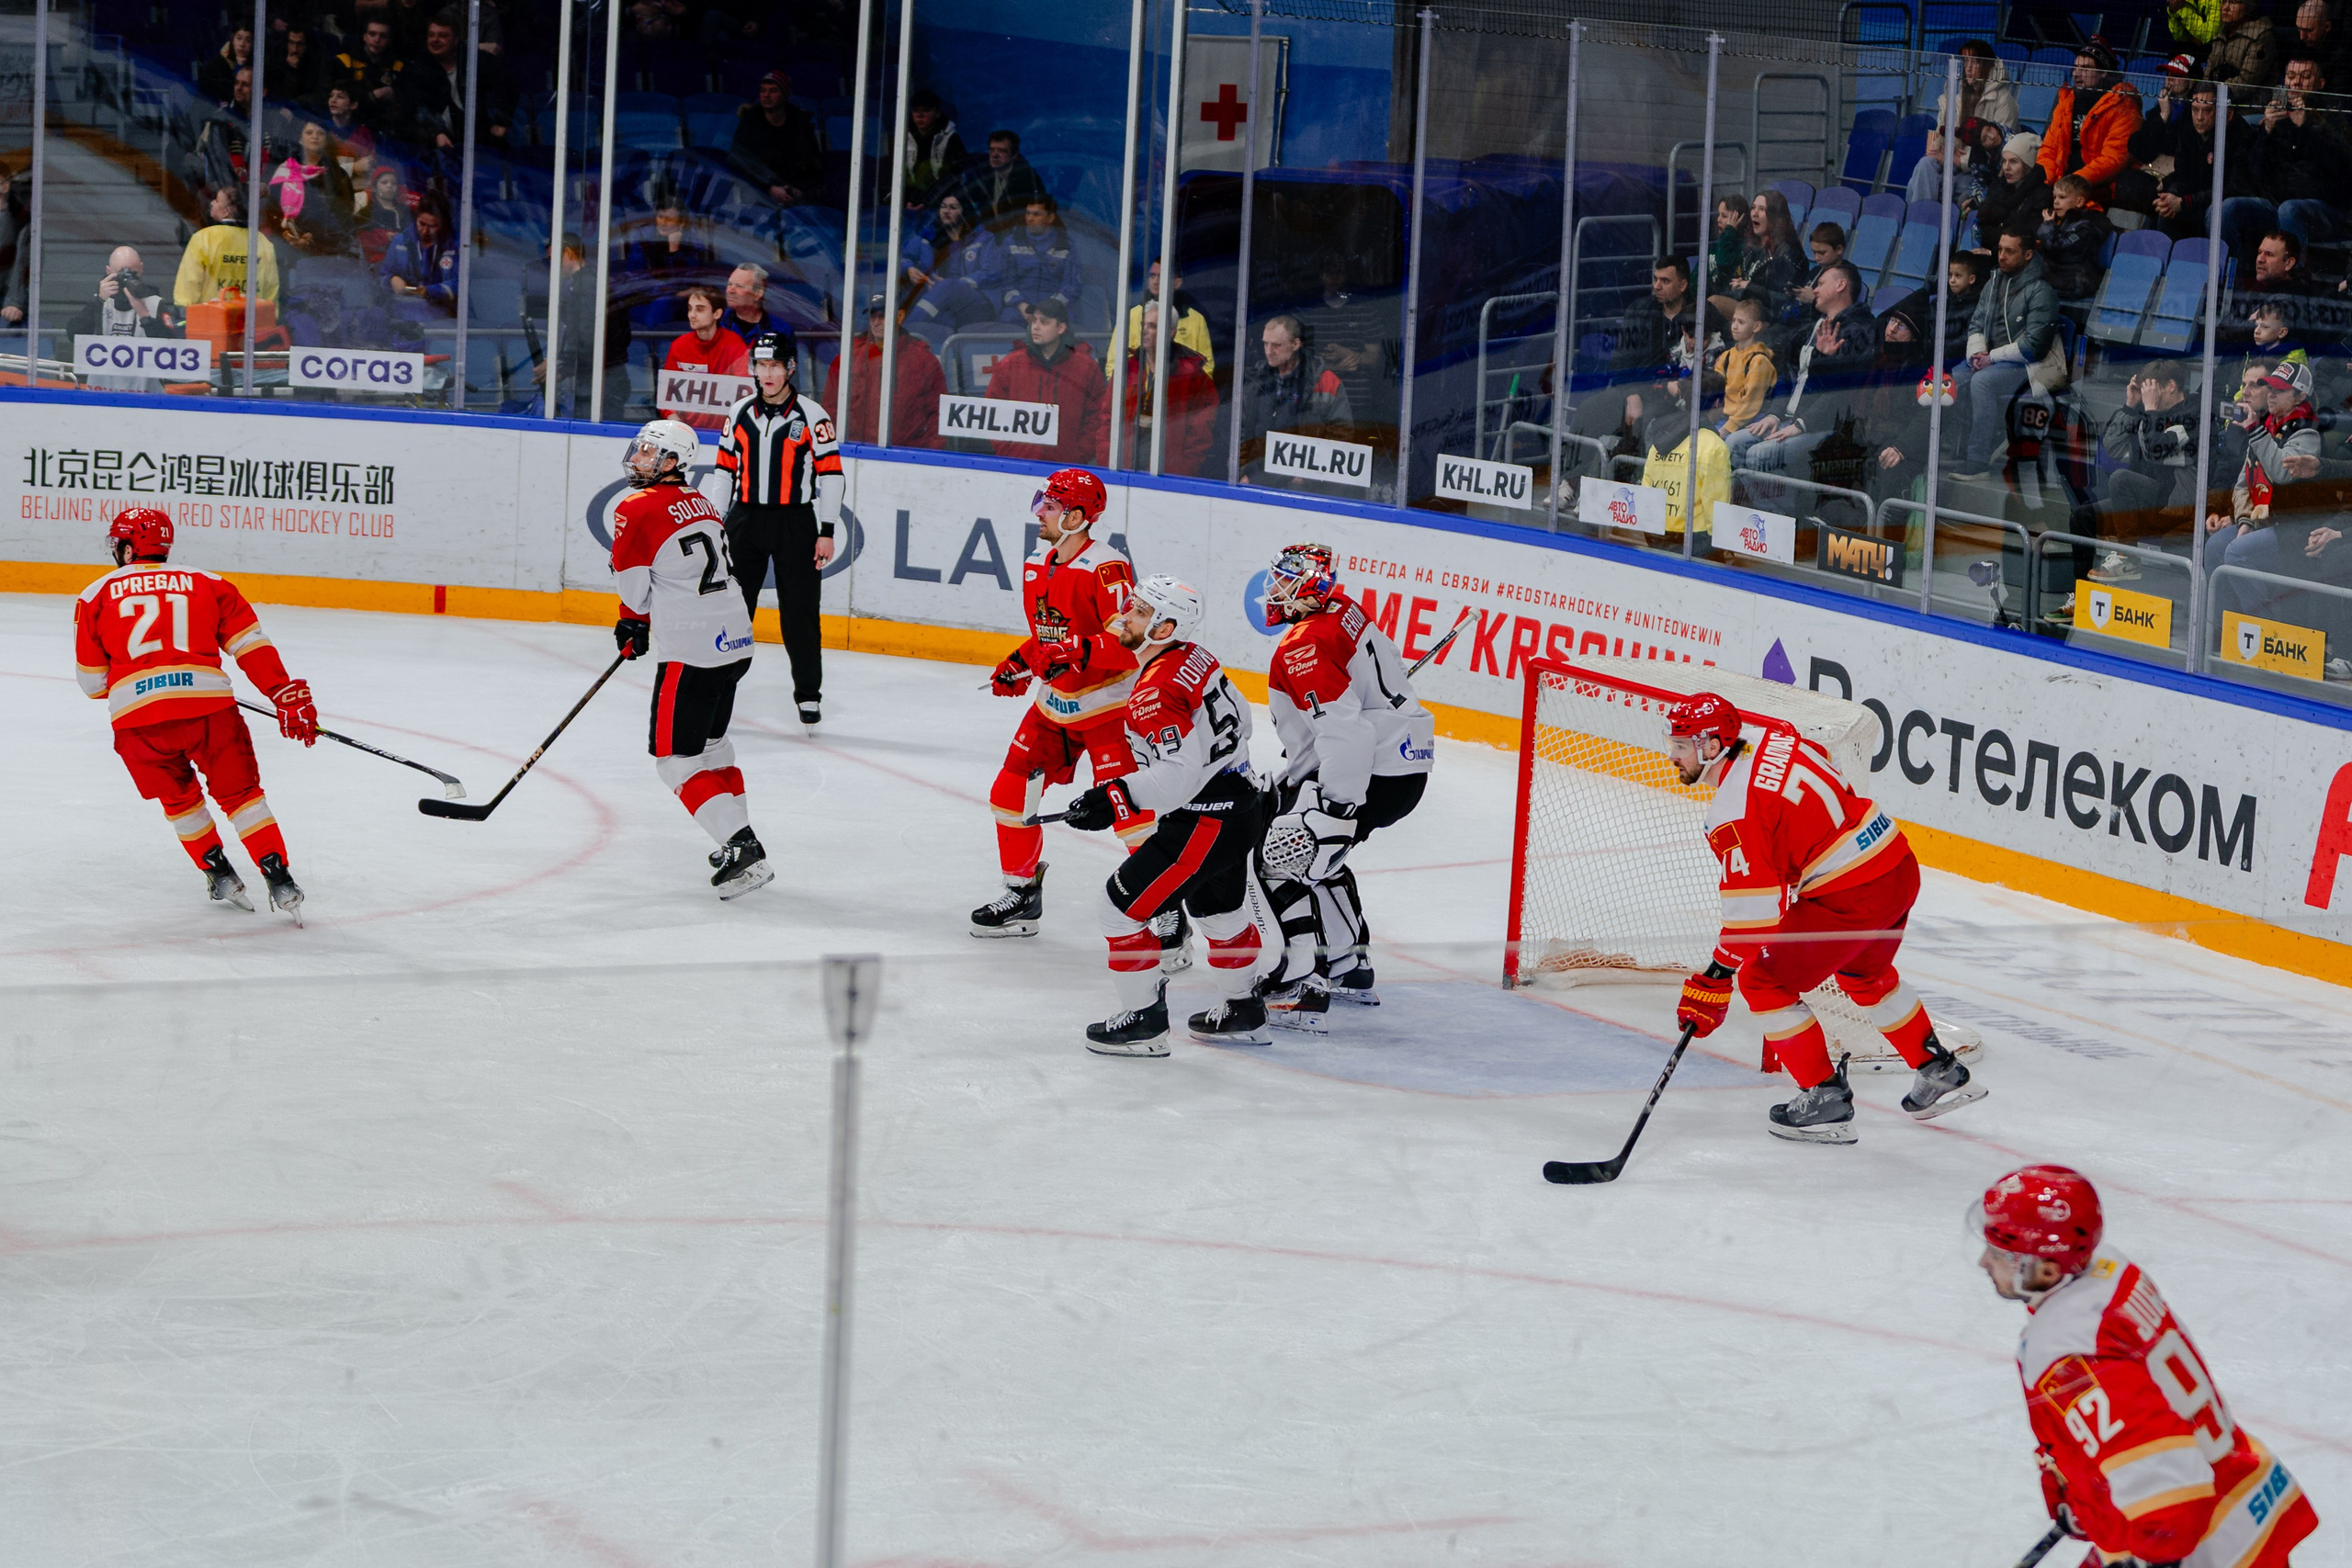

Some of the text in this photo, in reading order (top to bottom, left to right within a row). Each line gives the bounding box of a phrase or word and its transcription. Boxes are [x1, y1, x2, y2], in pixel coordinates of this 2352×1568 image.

[85, 343, 200, 371] согаз
[300, 355, 413, 384] согаз
[665, 378, 754, 407] KHL.R
[815, 421, 836, 444] 38
[947, 402, 1051, 436] KHL.RU
[1272, 440, 1367, 478] KHL.RU
[23, 446, 395, 505] 北京昆仑鸿星冰球俱乐部
[1442, 463, 1527, 501] KHL.RU
[21, 496, 92, 522] BEIJING
[178, 503, 212, 528] RED
[220, 505, 265, 530] STAR
[275, 507, 342, 535] HOCKEY
[349, 512, 394, 538] CLUB
[667, 497, 723, 525] SOLOVYE
[1612, 513, 1637, 525] РАДИО
[160, 526, 169, 537] 21
[1744, 539, 1768, 554] РАДИО
[1826, 532, 1894, 582] МАТЧ!
[109, 573, 194, 600] O'REGAN
[1348, 556, 1407, 580] ВСЕГДА
[1415, 568, 1433, 584] НА
[1442, 571, 1489, 593] СВЯЗИ
[1497, 582, 1620, 622] #REDSTARHOCKEY
[1624, 609, 1723, 647] #UNITEDWEWIN
[118, 592, 190, 661] 21
[2114, 604, 2155, 631] БАНК
[2263, 636, 2309, 662] БАНК
[135, 671, 194, 695] SIBUR
[1305, 689, 1327, 720] 1
[1855, 810, 1893, 852] SIBU
[2064, 1387, 2125, 1458] 92
[2246, 1461, 2292, 1527] SIB
